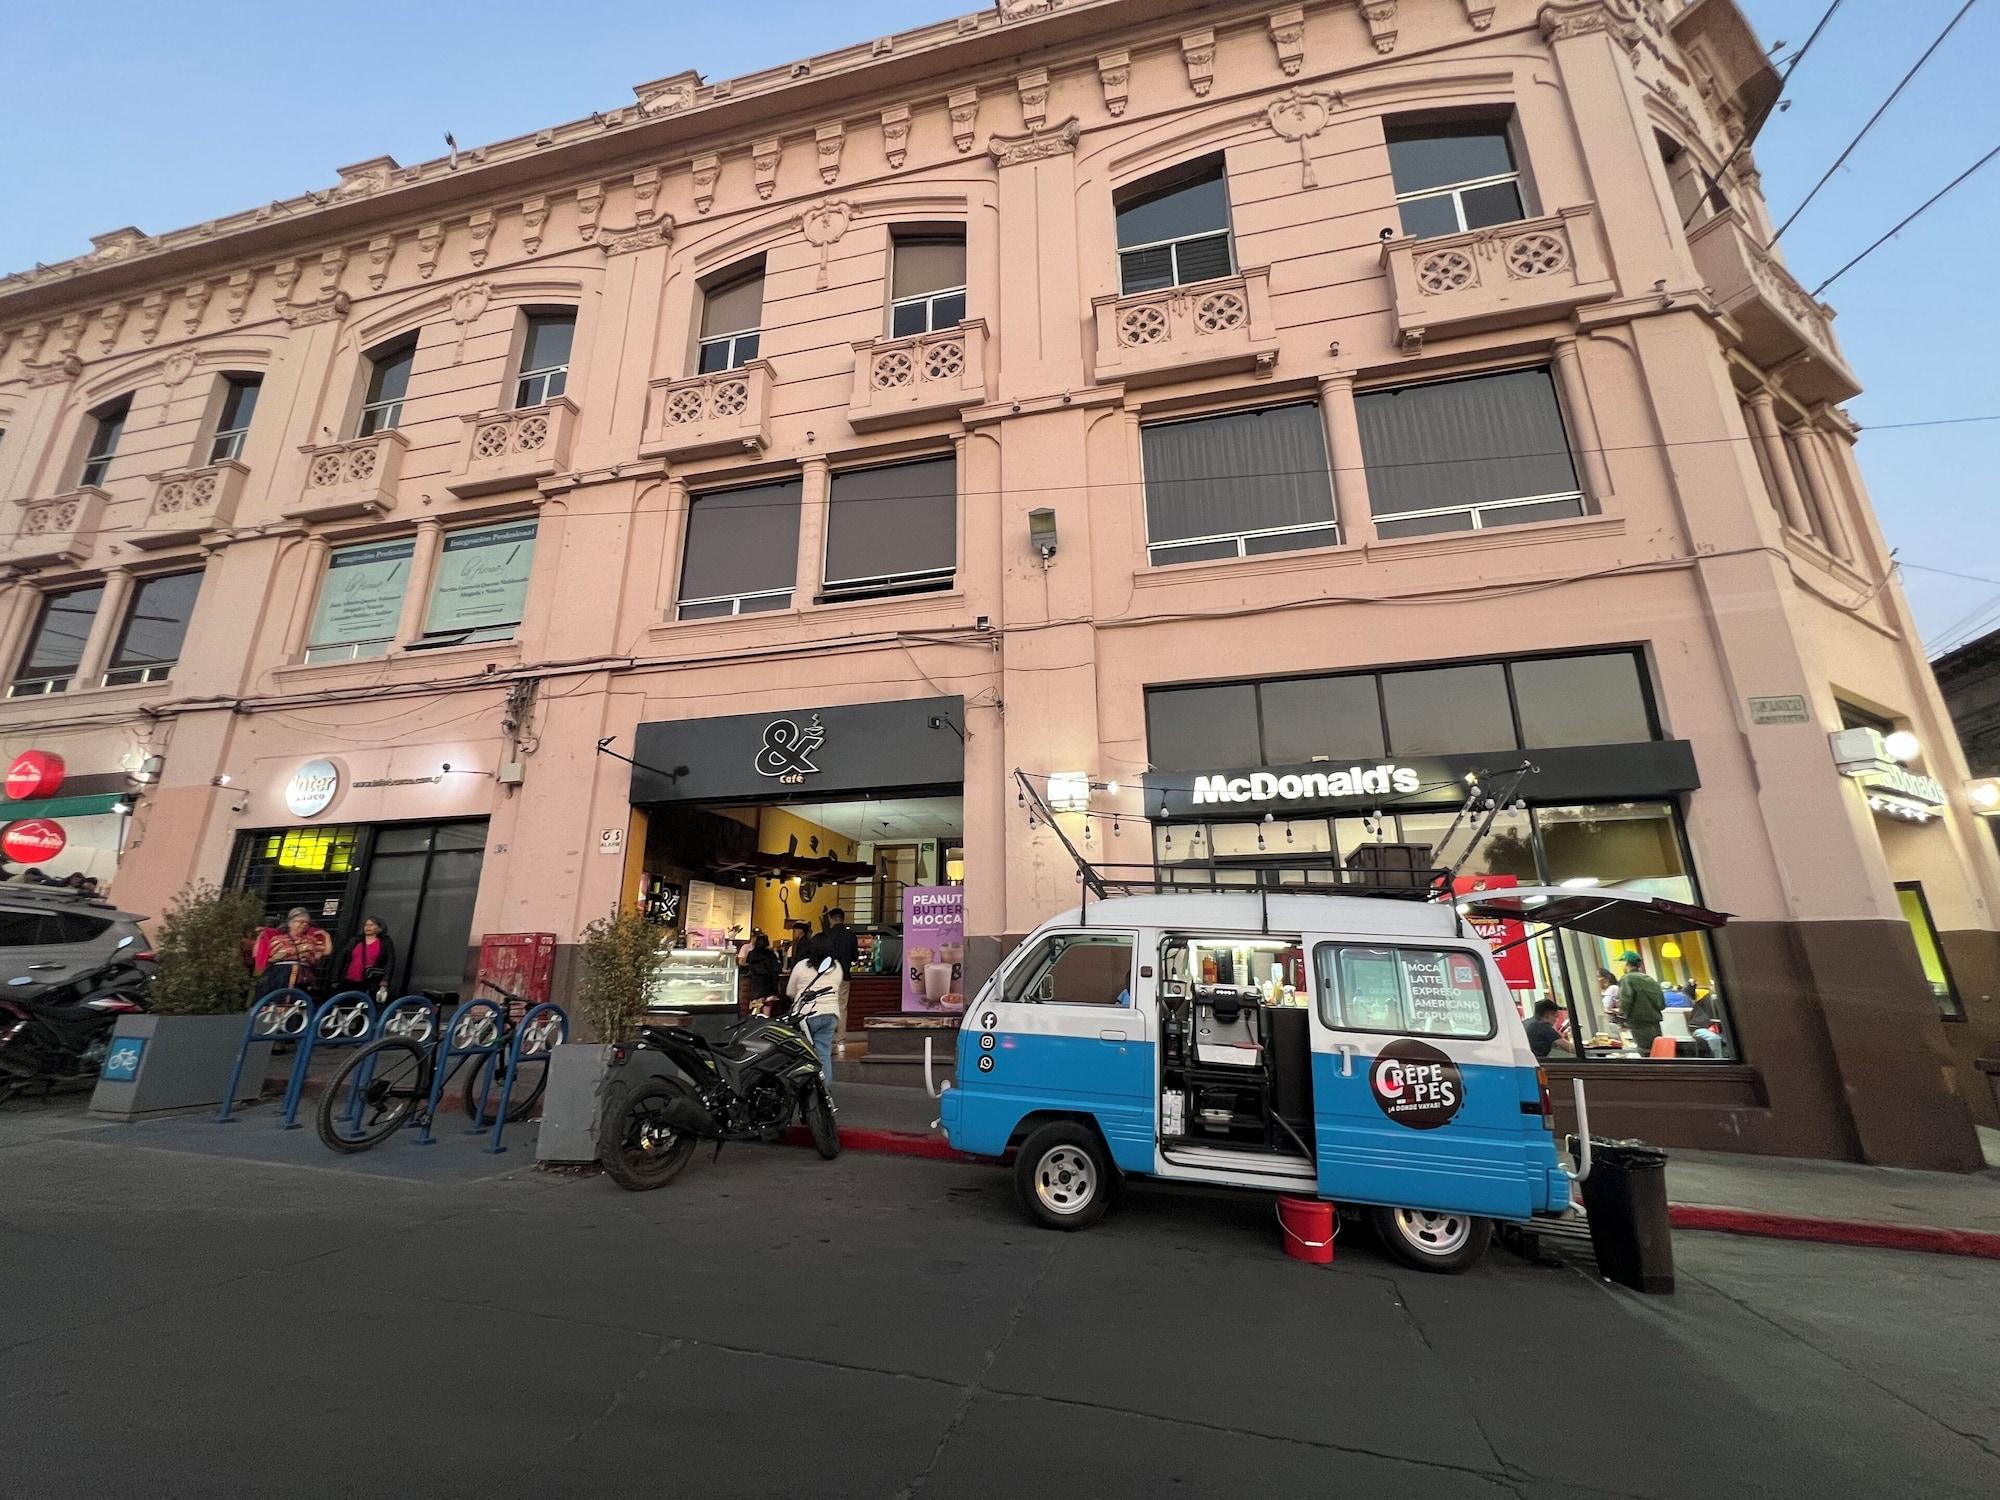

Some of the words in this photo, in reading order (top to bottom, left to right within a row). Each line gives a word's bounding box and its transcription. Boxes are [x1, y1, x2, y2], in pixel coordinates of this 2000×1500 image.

[1193, 764, 1420, 804] McDonald's
[912, 894, 962, 905] PEANUT
[913, 905, 963, 915] BUTTER
[912, 914, 962, 925] MOCCA
[1407, 963, 1441, 973] MOCA
[1410, 975, 1443, 985] LATTE
[1412, 986, 1462, 997] EXPRESO
[1414, 998, 1481, 1010] AMERICANO
